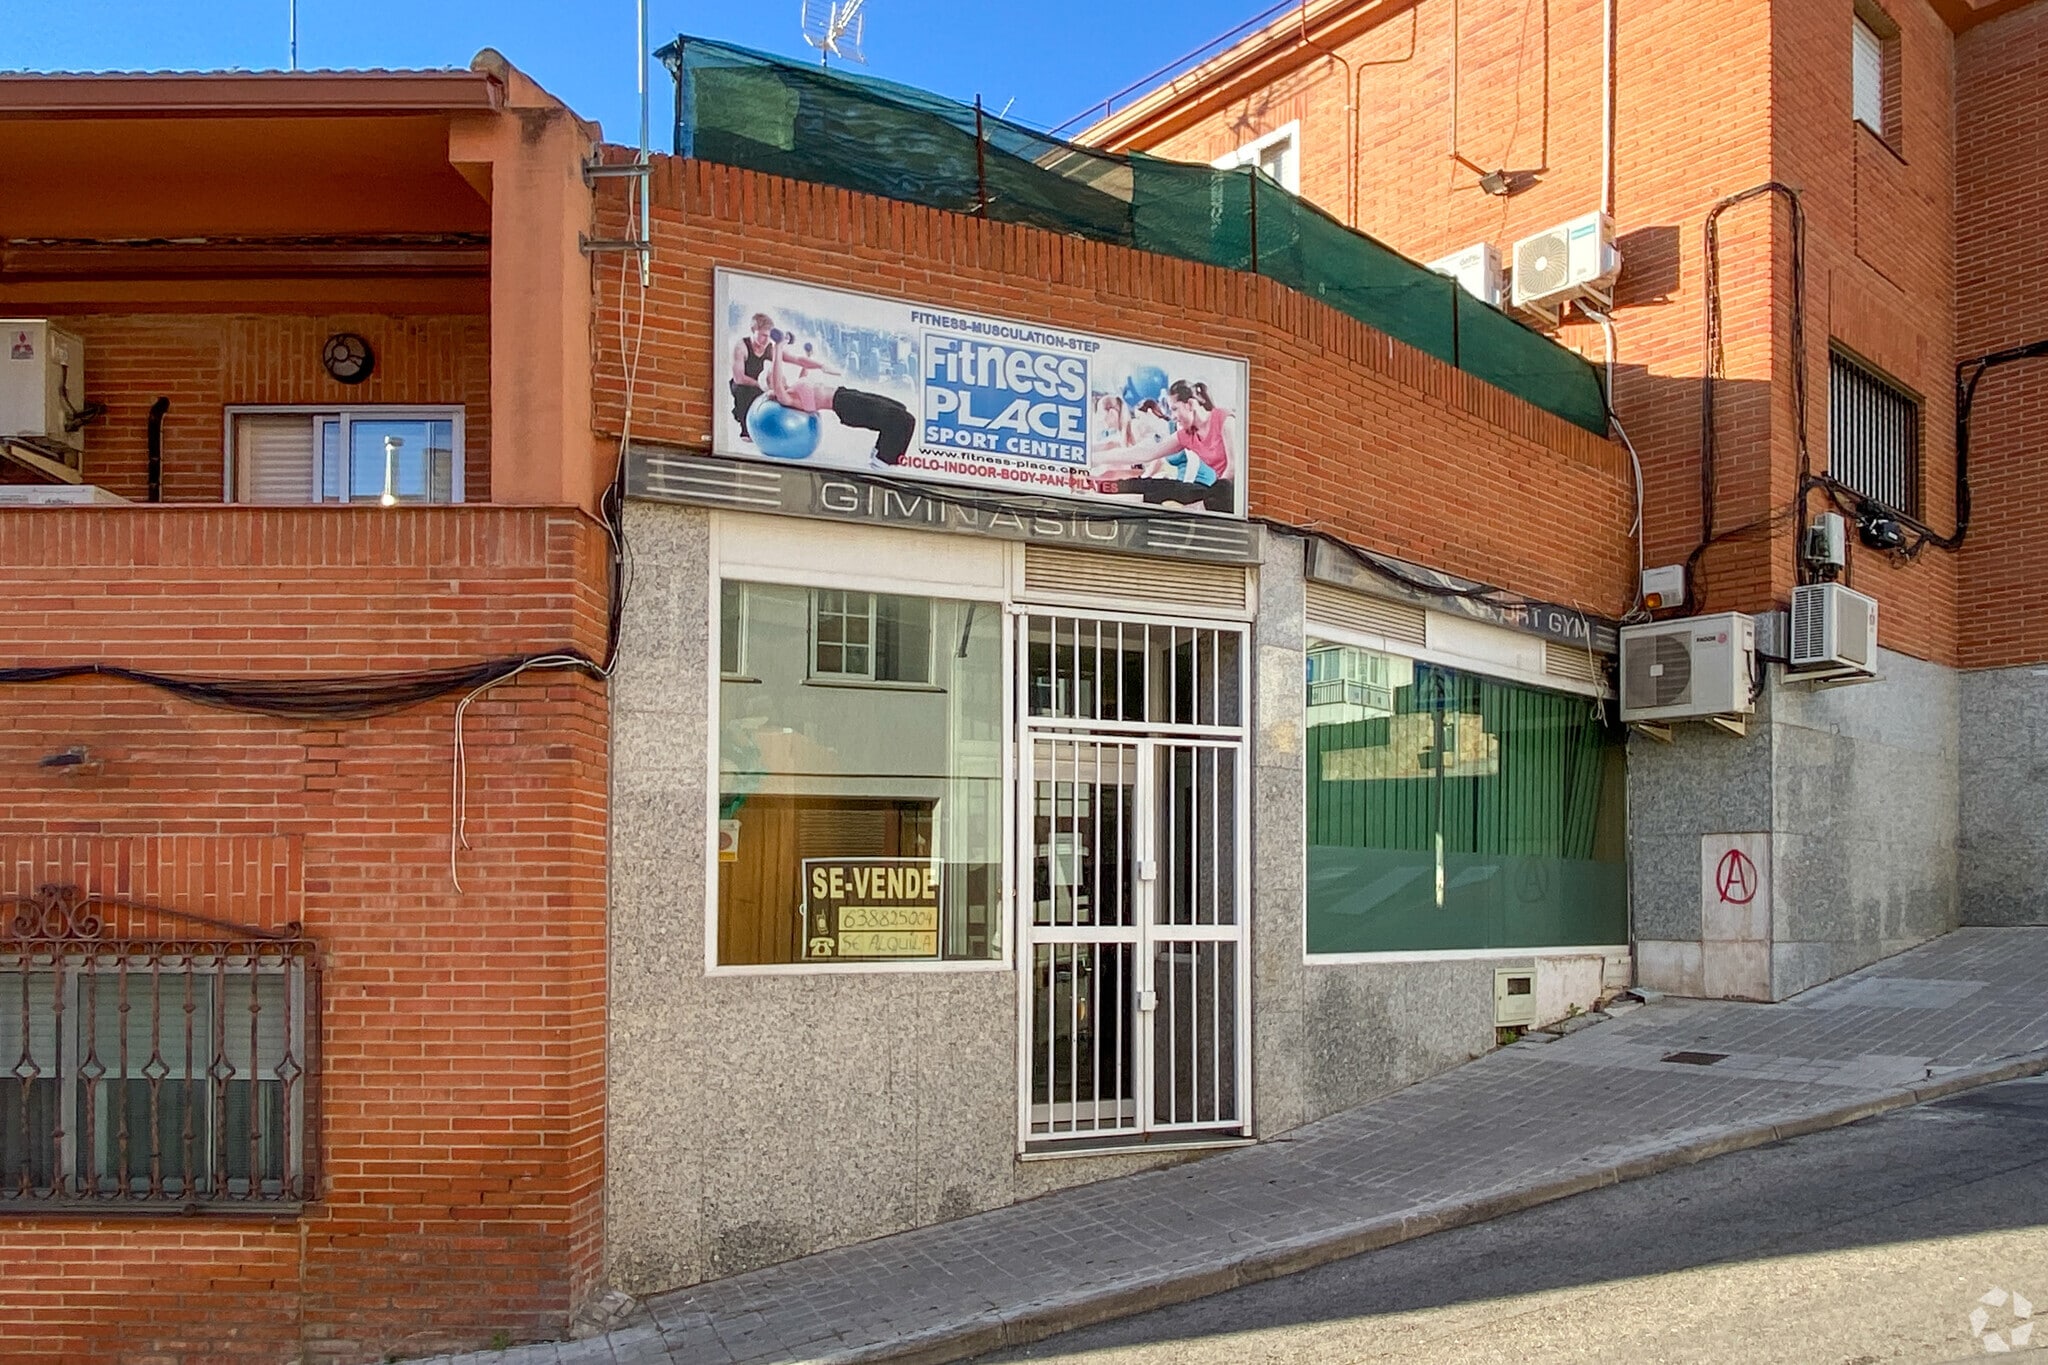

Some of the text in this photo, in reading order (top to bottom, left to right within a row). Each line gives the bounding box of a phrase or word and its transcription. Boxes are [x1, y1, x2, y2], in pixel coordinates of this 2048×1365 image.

[911, 310, 1100, 352] FITNESS-MUSCULATION-STEP
[926, 335, 1086, 402] Fitness
[926, 385, 1086, 442] PLACE
[918, 447, 1090, 477] www.fitness-place.com
[927, 426, 1085, 463] SPORT CENTER
[812, 867, 936, 899] SE-VENDE
